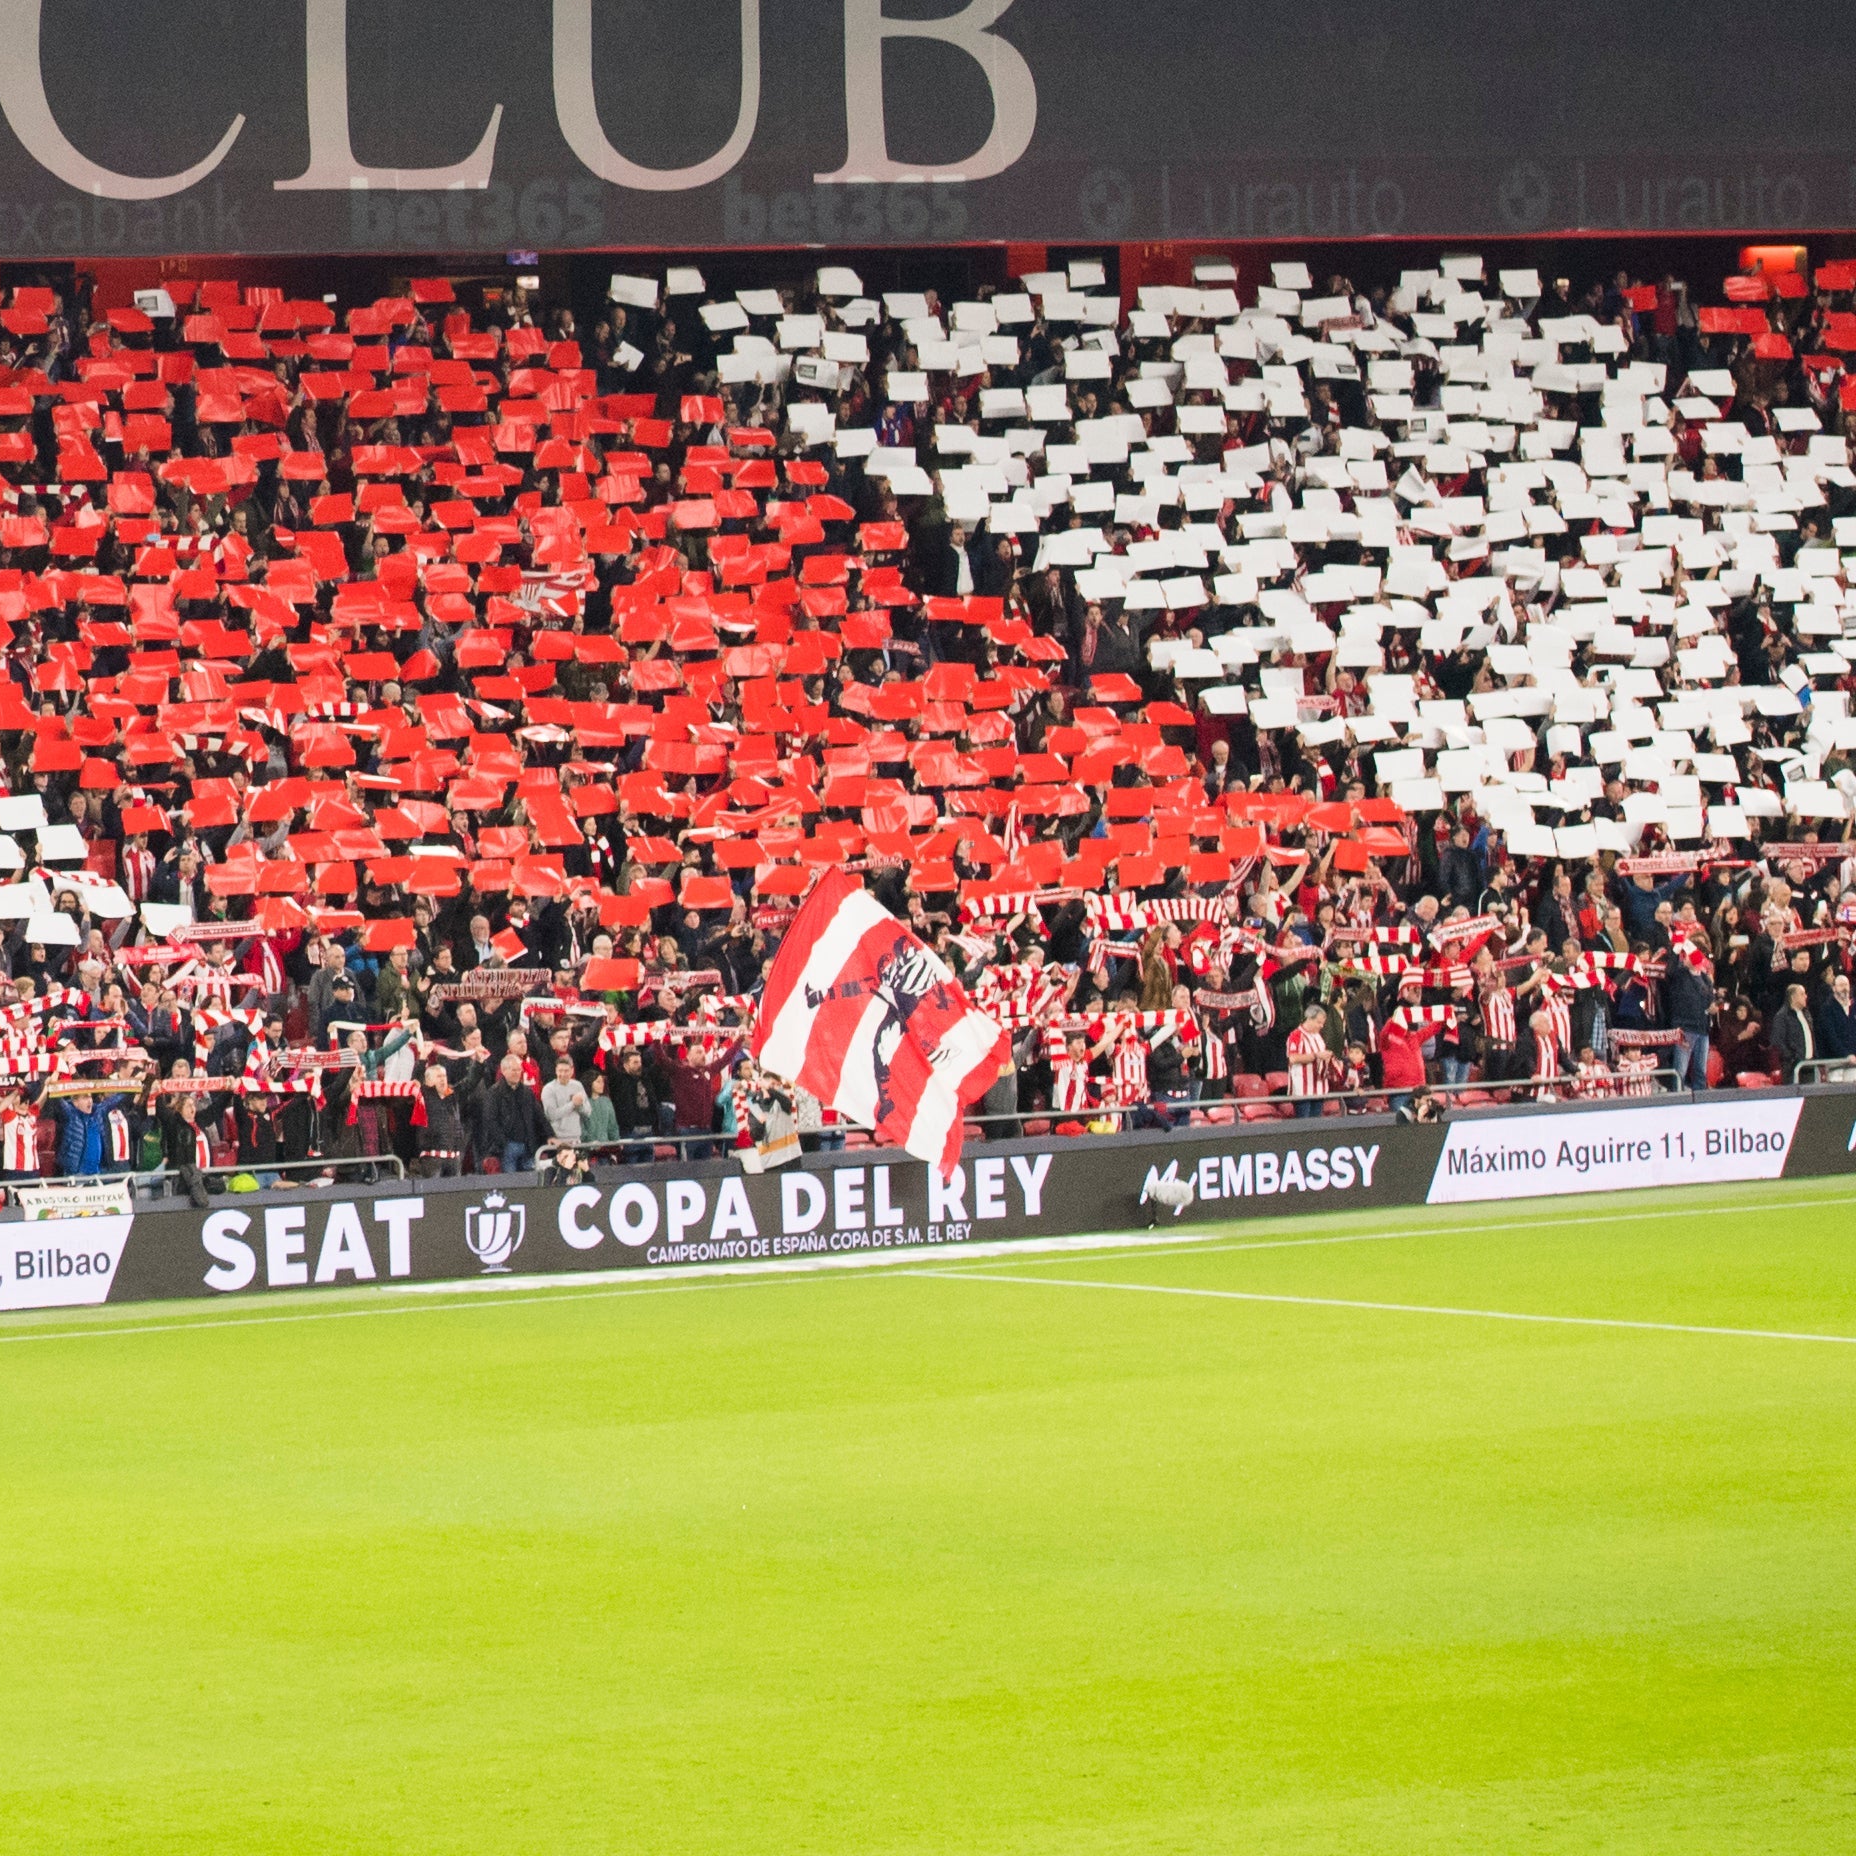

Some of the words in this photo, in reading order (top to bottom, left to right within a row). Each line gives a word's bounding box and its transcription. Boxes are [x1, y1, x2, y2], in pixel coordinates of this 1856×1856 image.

[1449, 1146, 1545, 1175] Máximo
[1557, 1140, 1651, 1172] Aguirre
[1662, 1133, 1696, 1164] 11,
[1705, 1128, 1785, 1156] Bilbao
[558, 1176, 758, 1250] COPA
[786, 1166, 904, 1235] DEL
[928, 1154, 1053, 1222] REY
[15, 1248, 111, 1280] Bilbao
[202, 1197, 425, 1291] SEAT
[647, 1239, 747, 1264] CAMPEONATO
[751, 1238, 771, 1256] DE
[774, 1232, 827, 1254] ESPAÑA
[830, 1231, 871, 1251] COPA
[873, 1229, 892, 1247] DE
[895, 1227, 924, 1245] S.M.
[928, 1225, 944, 1243] EL
[946, 1223, 972, 1241] REY
